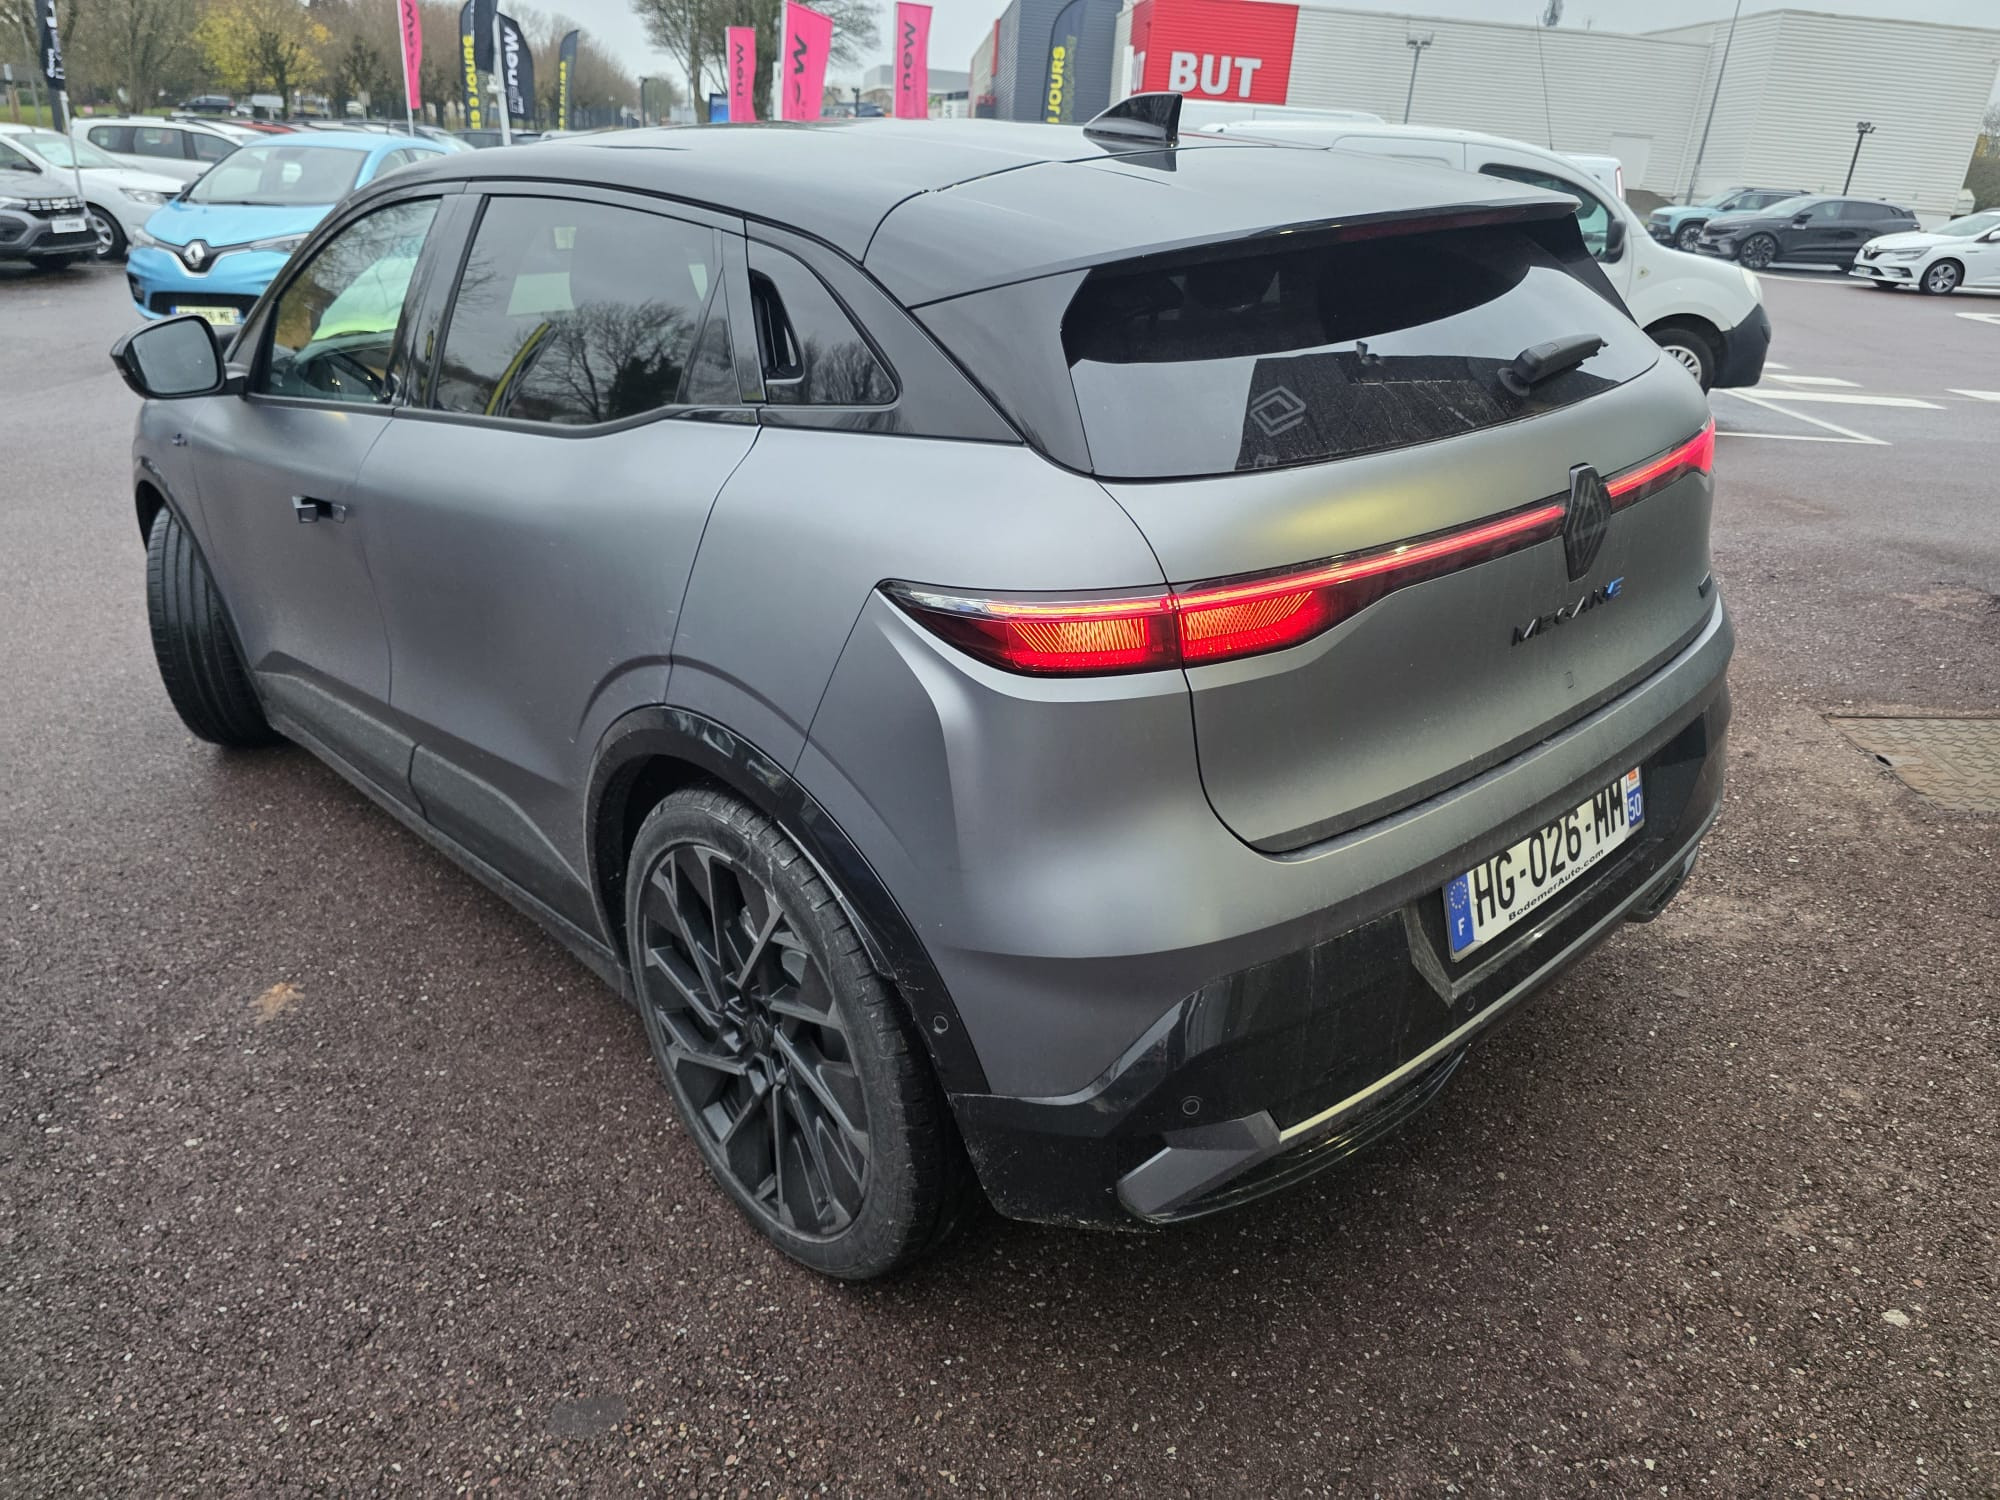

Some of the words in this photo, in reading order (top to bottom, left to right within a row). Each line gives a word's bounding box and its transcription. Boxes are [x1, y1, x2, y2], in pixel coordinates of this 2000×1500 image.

[1046, 45, 1066, 115] JOURS
[1168, 50, 1263, 98] BUT
[1628, 792, 1642, 821] 50
[1473, 776, 1626, 928] HG-026-MM
[1508, 848, 1605, 922] BodemerAuto.com
[1457, 917, 1465, 937] F
